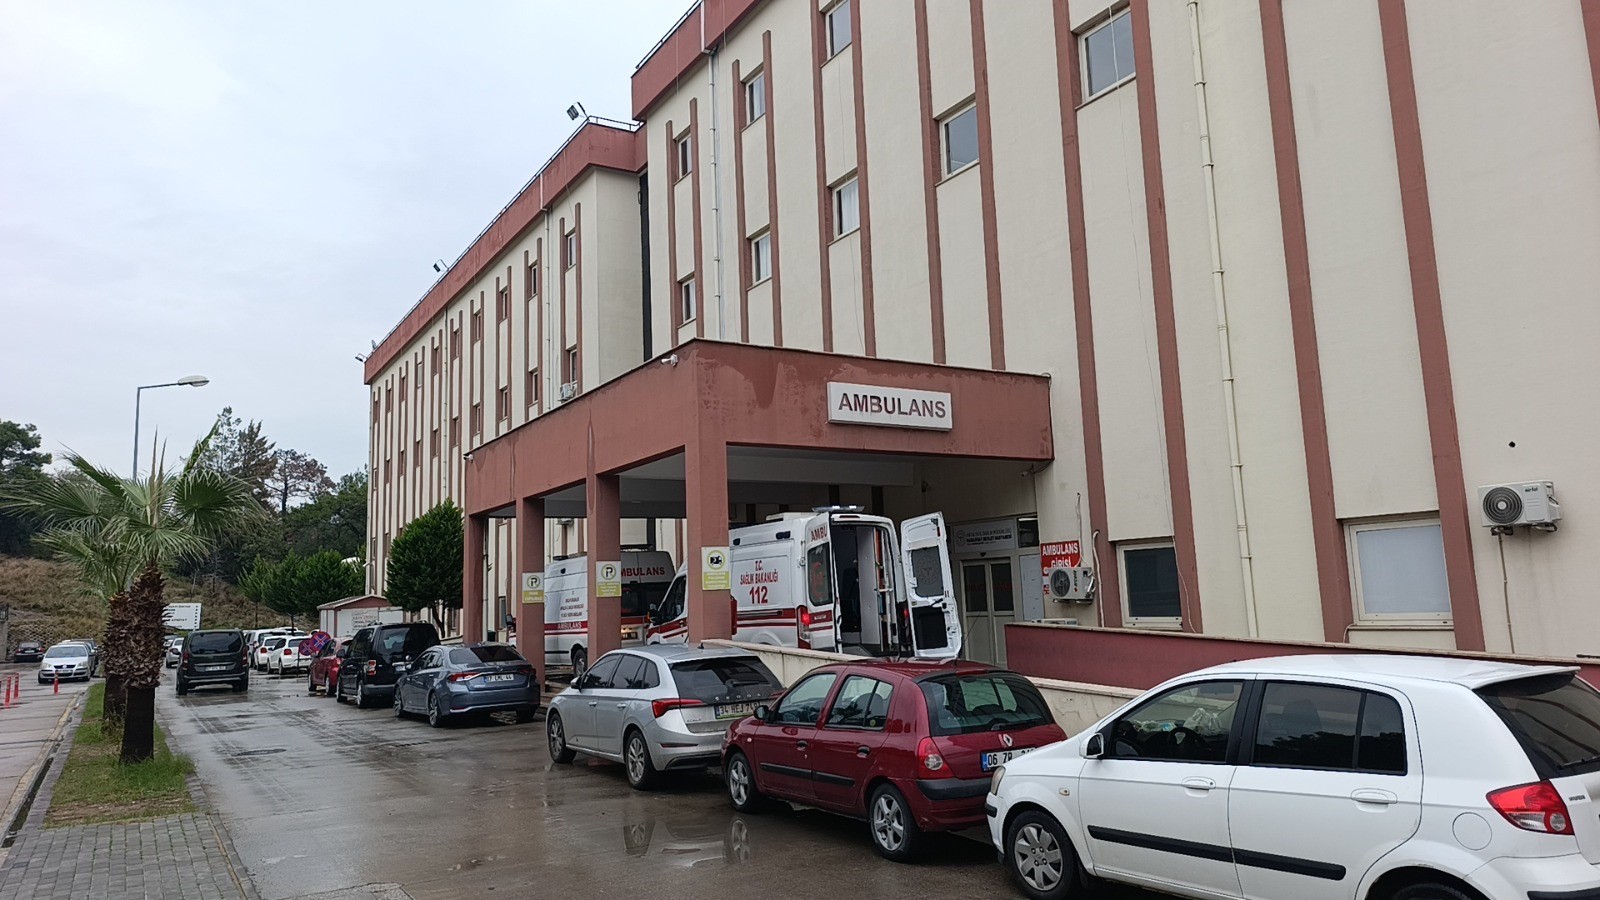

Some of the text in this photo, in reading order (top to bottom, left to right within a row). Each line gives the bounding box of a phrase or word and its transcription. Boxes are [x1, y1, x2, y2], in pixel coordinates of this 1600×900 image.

[838, 392, 946, 418] AMBULANS
[810, 526, 828, 542] AMBU
[1042, 543, 1079, 556] AMBULANS
[620, 567, 666, 577] MBULANS
[740, 572, 754, 585] SAĞLIK
[755, 569, 778, 584] BAKANLIĞI
[749, 586, 768, 604] 112
[720, 706, 729, 715] 34
[731, 704, 744, 714] HEJ
[988, 753, 998, 766] 06
